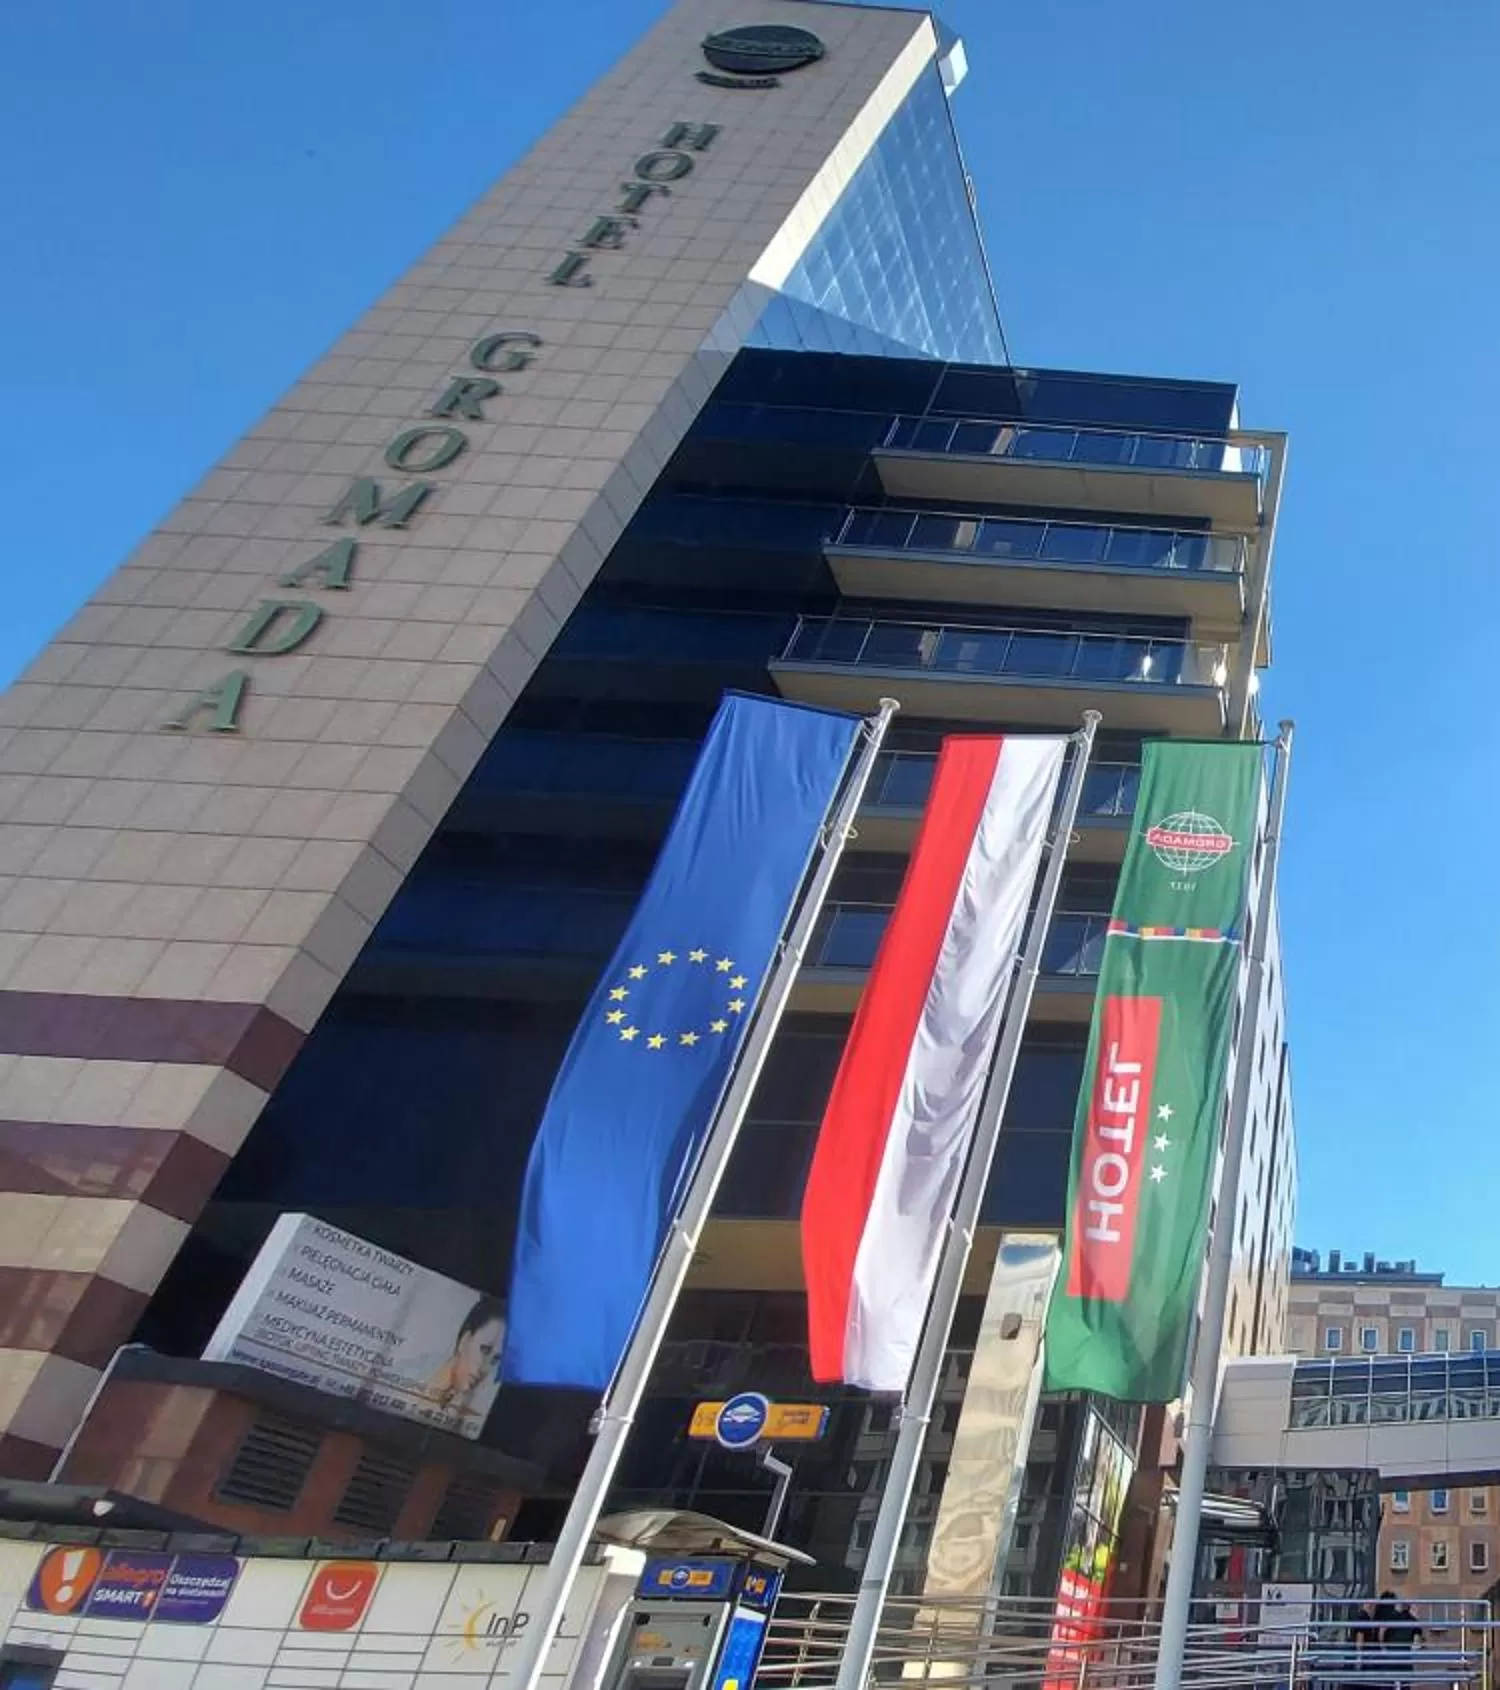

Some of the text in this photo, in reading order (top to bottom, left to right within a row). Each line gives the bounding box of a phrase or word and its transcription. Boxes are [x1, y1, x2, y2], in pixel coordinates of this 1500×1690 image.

[544, 121, 721, 288] HOTEL
[162, 331, 542, 732] GROMADA
[485, 1611, 566, 1636] InPt
